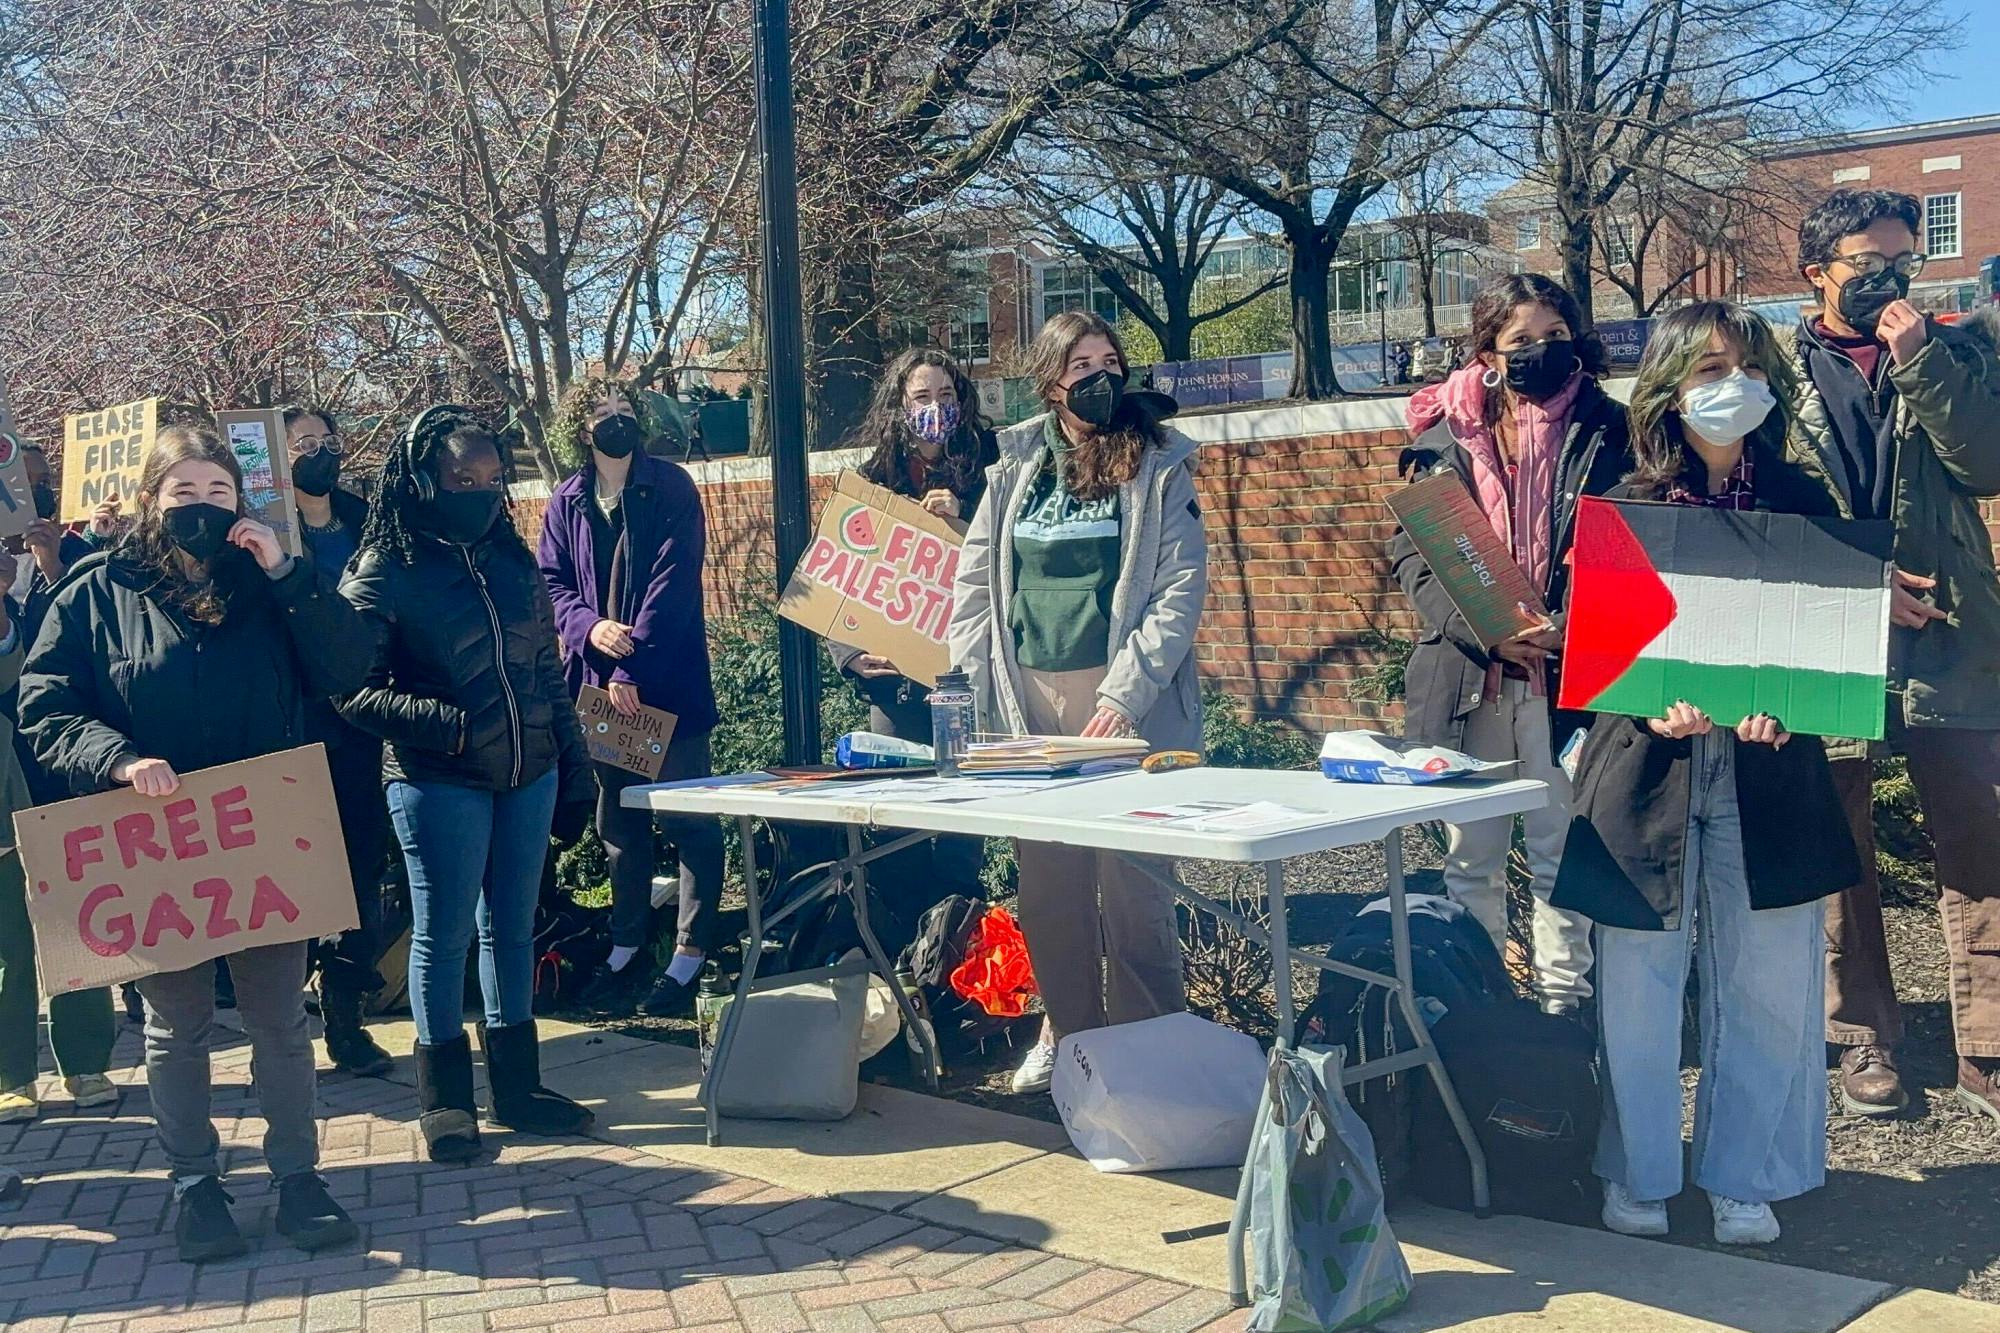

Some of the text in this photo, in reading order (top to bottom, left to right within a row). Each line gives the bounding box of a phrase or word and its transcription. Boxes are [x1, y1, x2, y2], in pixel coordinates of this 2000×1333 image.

[1628, 329, 1640, 341] &
[76, 404, 144, 440] CEASE
[85, 434, 143, 475] FIRE
[81, 472, 140, 508] NOW
[884, 525, 960, 591] FRE
[1454, 534, 1496, 587] FOR THE
[804, 538, 954, 641] PALESTI
[618, 733, 632, 748] IS
[623, 752, 650, 773] THE
[64, 786, 255, 881] FREE
[79, 875, 299, 957] GAZA
